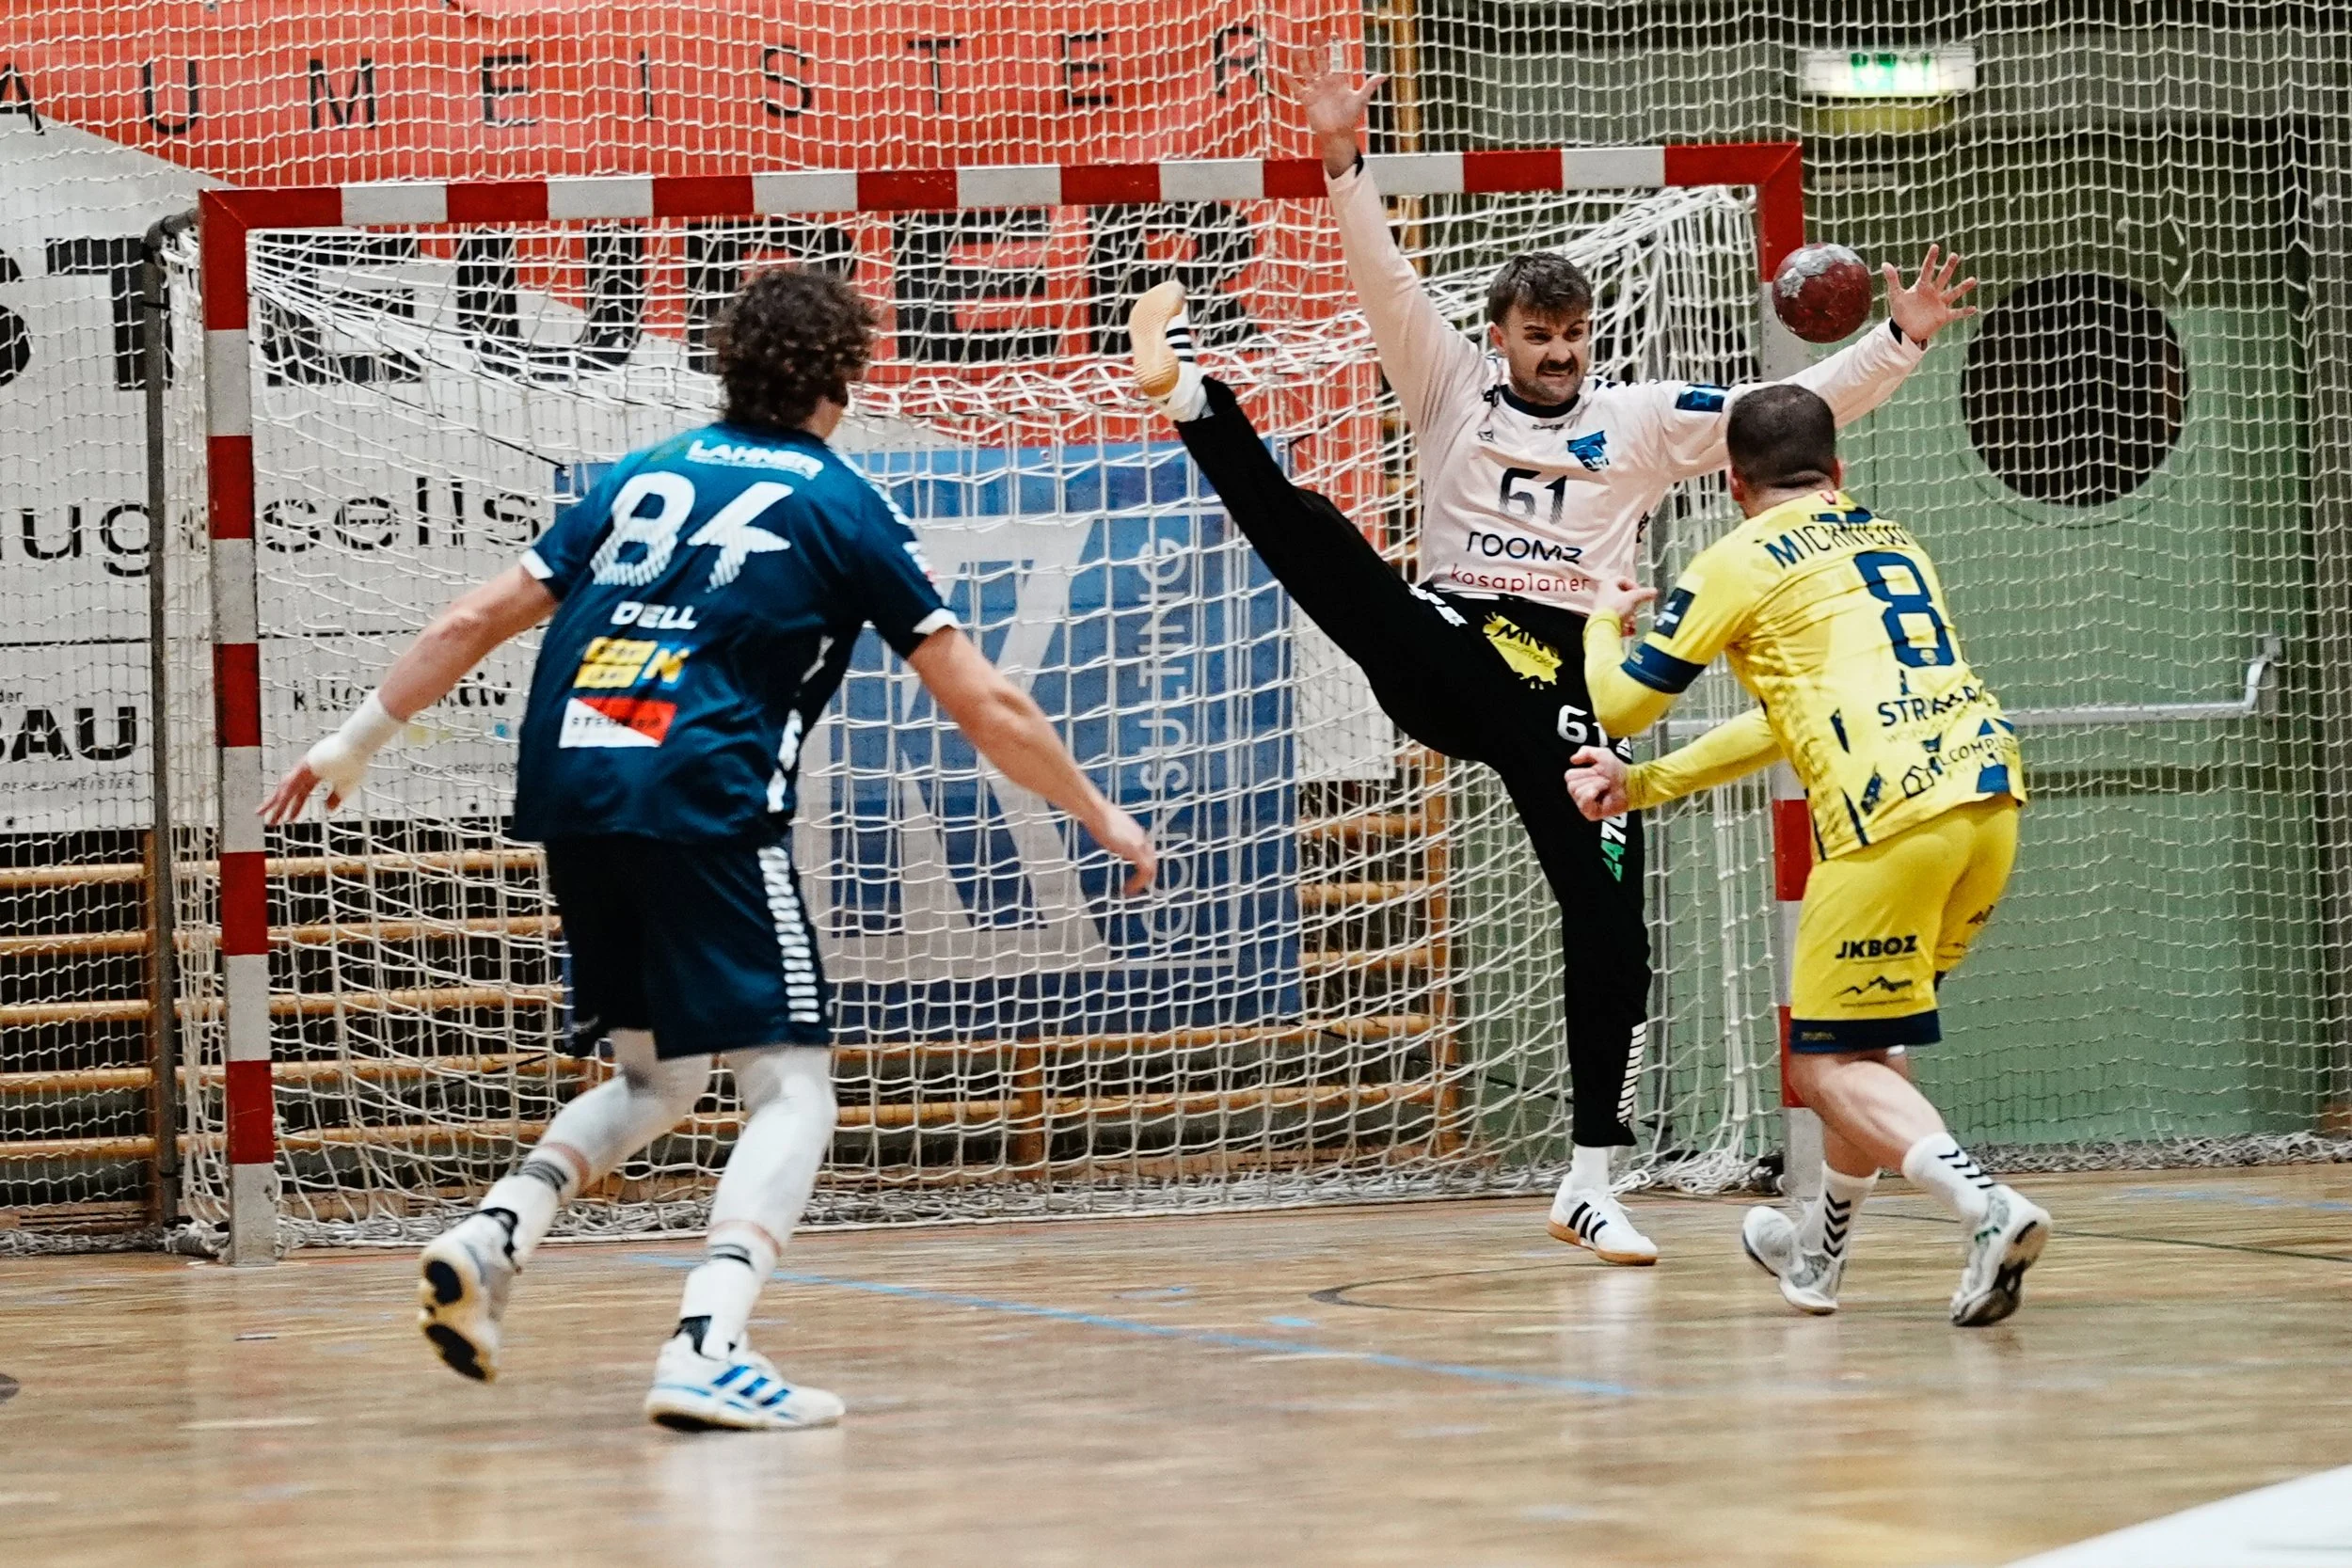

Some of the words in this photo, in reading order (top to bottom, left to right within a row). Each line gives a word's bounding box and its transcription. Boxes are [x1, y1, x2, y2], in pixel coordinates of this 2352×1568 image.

[0, 200, 1257, 390] TEURER
[1499, 467, 1567, 525] 61
[612, 601, 697, 629] DELL
[1854, 551, 1957, 668] 8
[0, 706, 137, 762] AU
[1137, 537, 1191, 941] CONSULTING
[1836, 935, 1917, 958] JKBOZ
